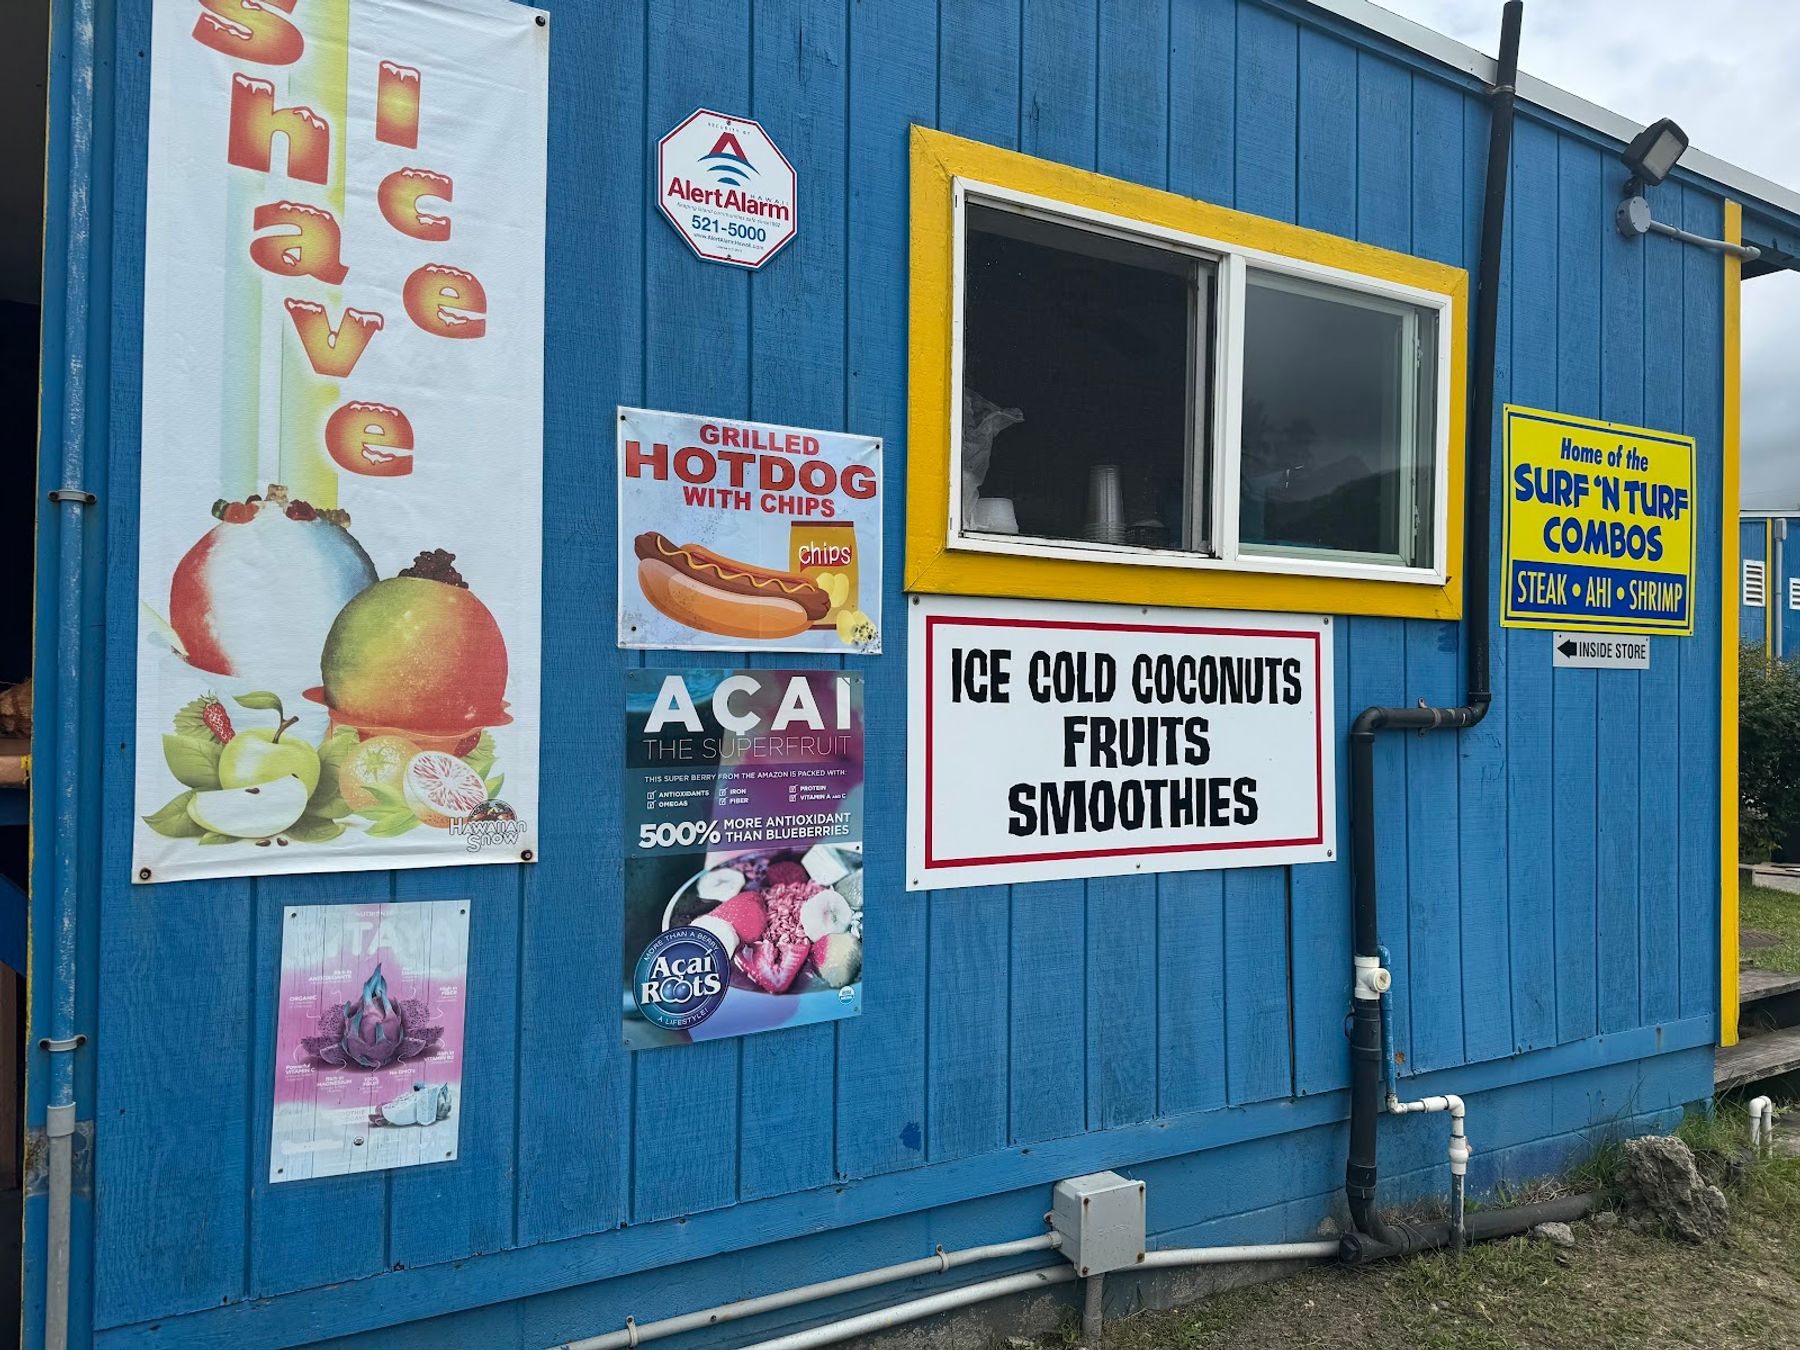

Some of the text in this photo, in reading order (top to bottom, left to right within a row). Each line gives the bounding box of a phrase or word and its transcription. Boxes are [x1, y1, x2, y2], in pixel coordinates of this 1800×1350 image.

[376, 60, 487, 339] Ice
[667, 177, 789, 221] AlertAlarm
[192, 0, 414, 477] Shave
[692, 215, 766, 242] 521-5000
[699, 424, 820, 456] GRILLED
[1560, 437, 1649, 472] Home of the
[625, 440, 877, 500] HOTDOG
[683, 486, 835, 517] WITH CHIPS
[1513, 463, 1589, 508] SURF
[1624, 480, 1689, 520] TURF
[1543, 517, 1663, 561] COMBOS
[1517, 571, 1682, 612] STEAK AHI SHRIMP
[1579, 641, 1646, 659] INSIDE STORE
[951, 648, 1302, 705] ICE COLD COCONUTS
[643, 675, 851, 736] AÇAI
[642, 735, 852, 760] THE SUPERFRUIT
[1064, 715, 1210, 768] FRUITS
[664, 774, 690, 783] SUPER
[690, 773, 716, 781] BERRY
[757, 771, 789, 779] AMAZON
[798, 769, 826, 777] PACKED
[723, 812, 852, 830] MORE ANTIOXIDANT
[1008, 777, 1259, 837] SMOOTHIES
[638, 820, 721, 850] 500%
[724, 824, 850, 843] THAN BLUEBERRIES
[644, 939, 664, 962] MORE
[664, 931, 688, 942] THAN
